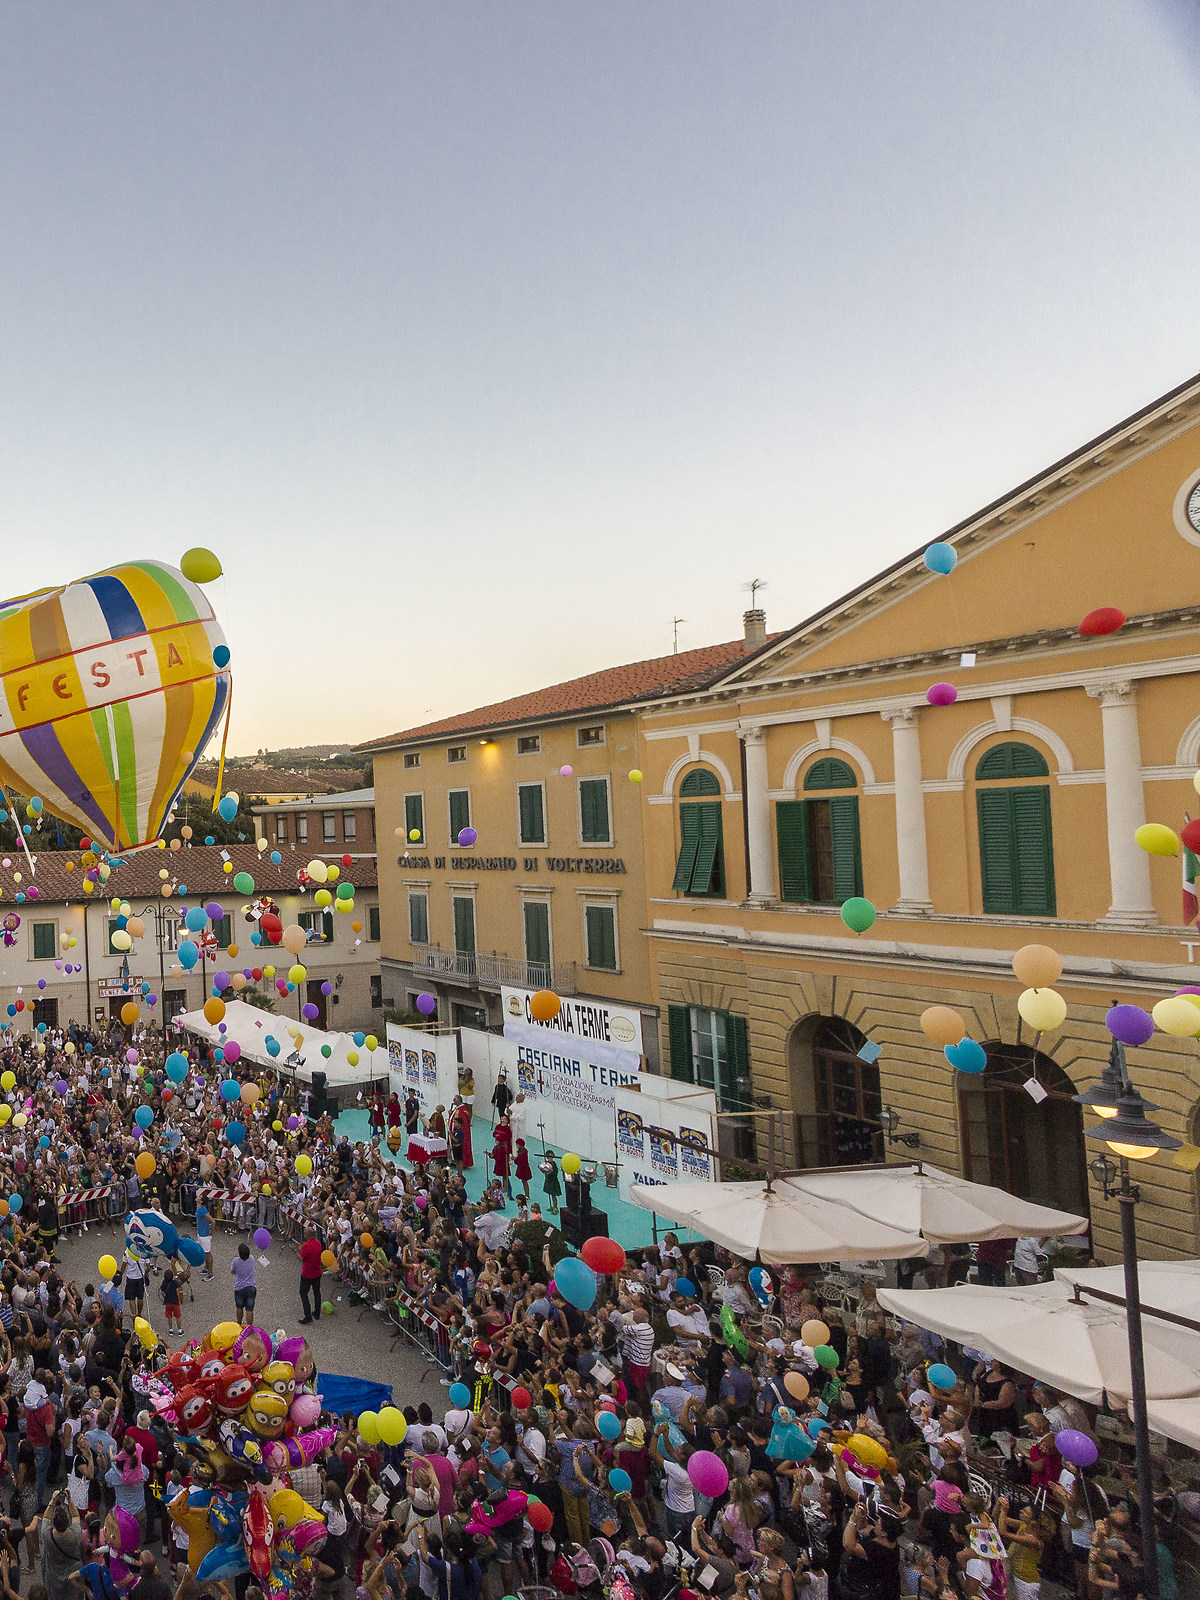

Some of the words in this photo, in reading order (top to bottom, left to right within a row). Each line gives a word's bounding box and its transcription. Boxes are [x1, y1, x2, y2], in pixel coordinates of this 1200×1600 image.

[17, 642, 184, 712] FESTA
[397, 856, 431, 869] CASSA
[434, 857, 446, 870] DI
[451, 857, 516, 871] RISPARMIO
[523, 857, 538, 872] DI
[546, 857, 627, 875] VOLTERRA
[575, 1004, 611, 1041] TERME
[518, 1045, 581, 1078] CASCIANA
[552, 1073, 595, 1094] FONDAZIONE
[553, 1084, 573, 1096] CASSA
[574, 1089, 582, 1099] DI
[553, 1092, 560, 1101] DI
[560, 1093, 593, 1112] VOLTERRA
